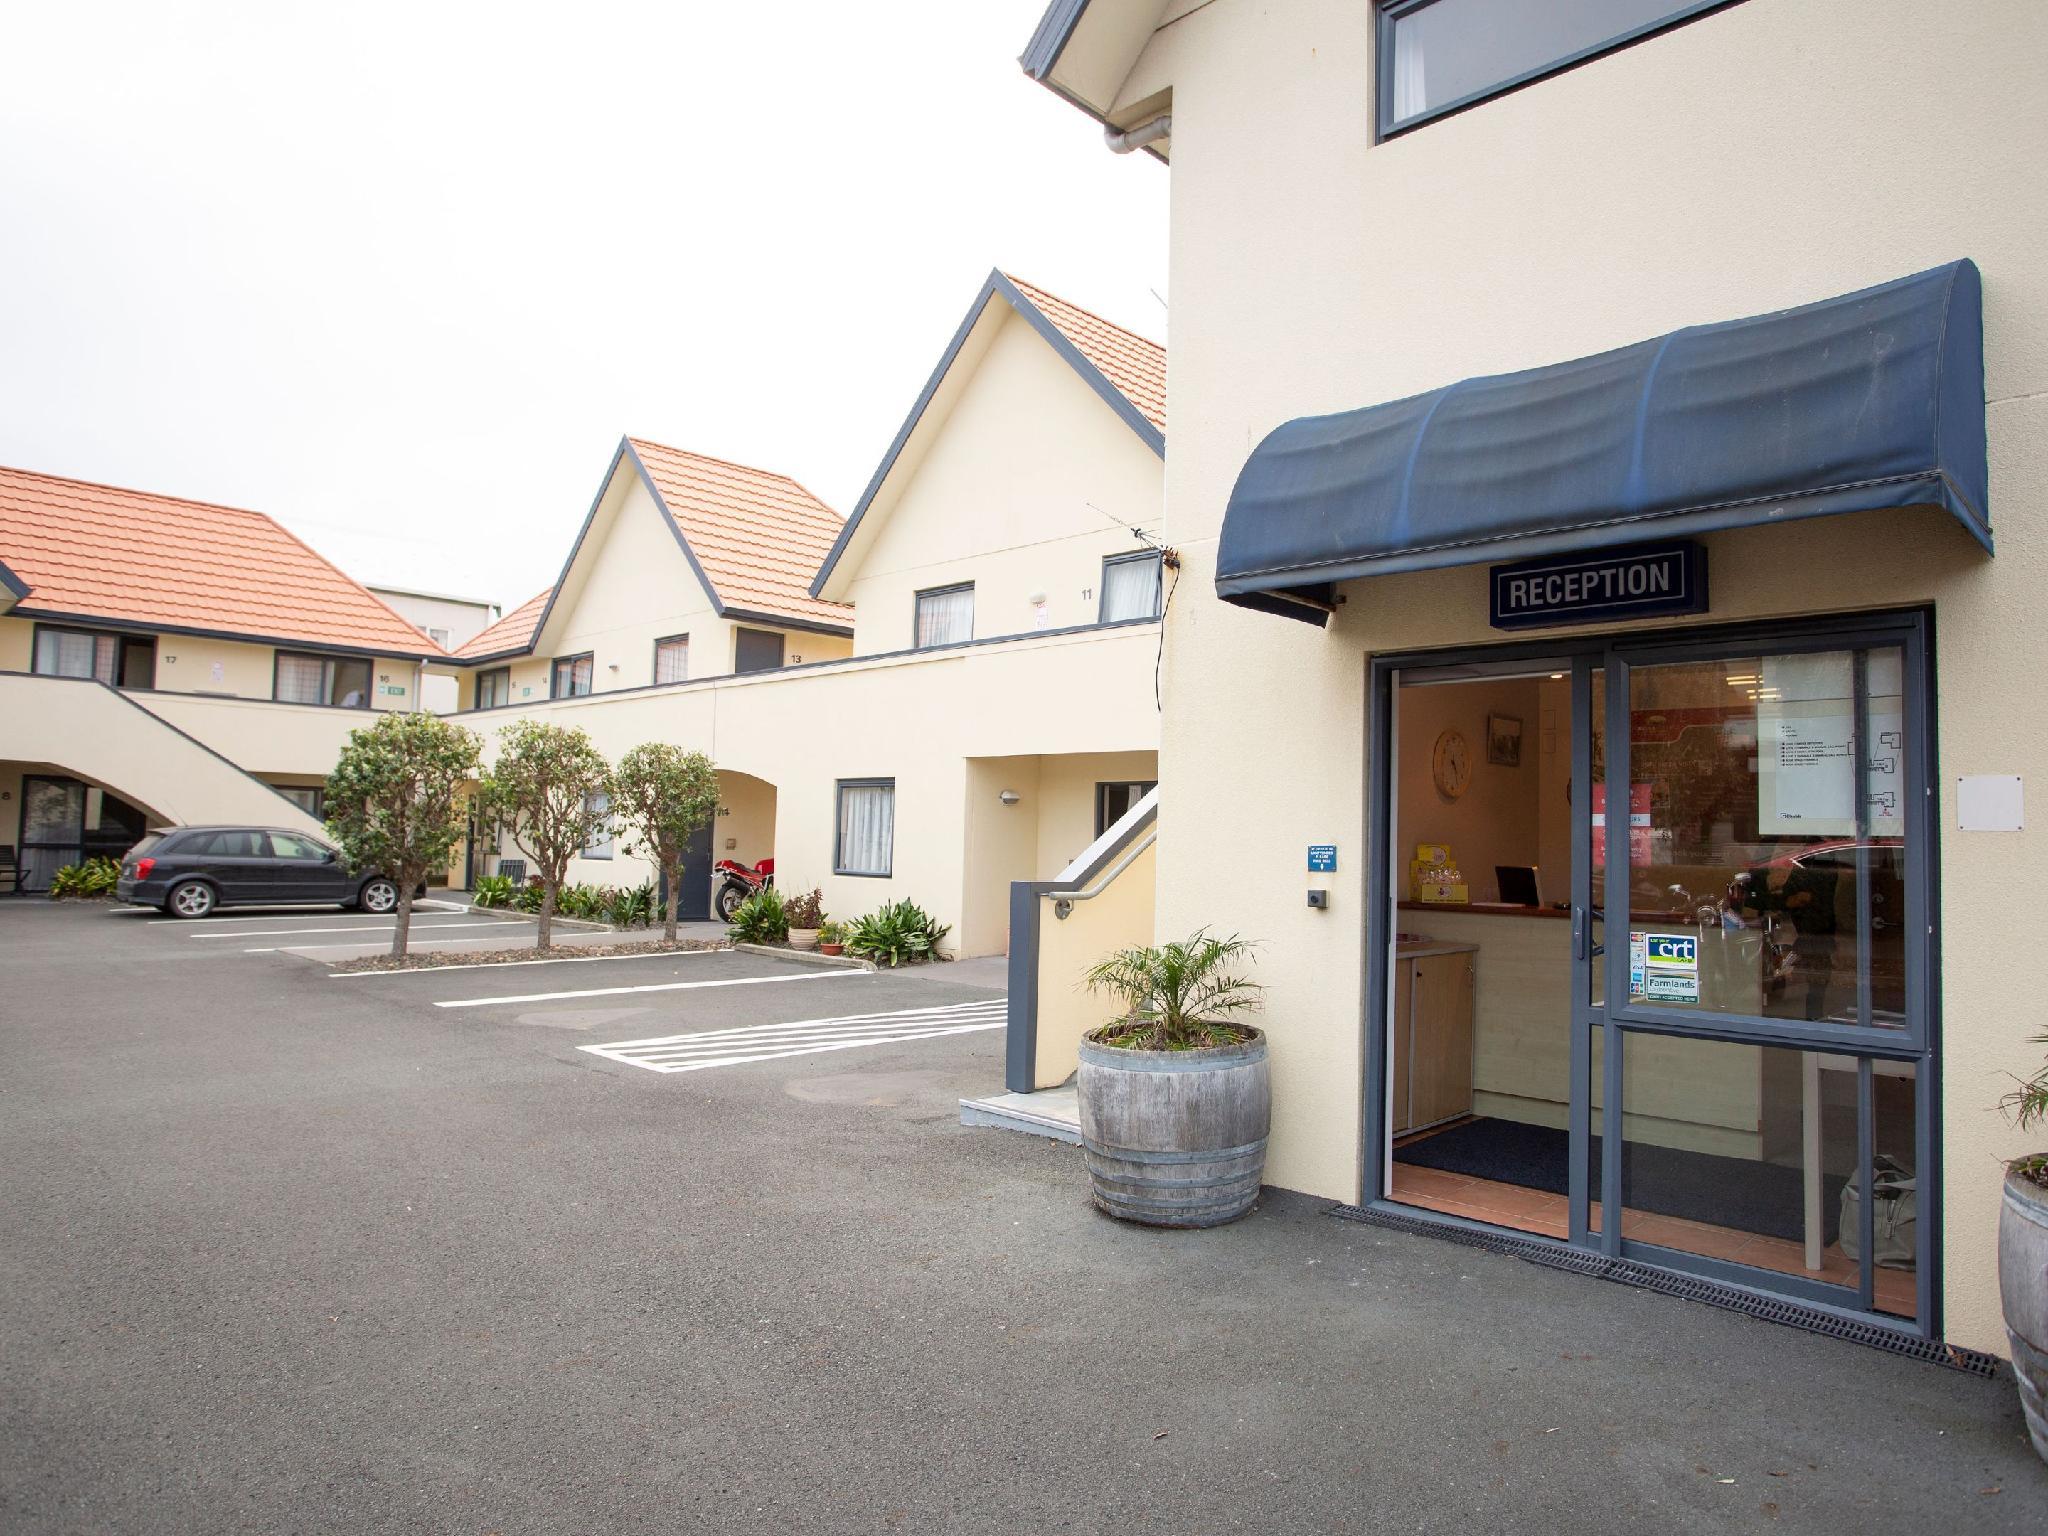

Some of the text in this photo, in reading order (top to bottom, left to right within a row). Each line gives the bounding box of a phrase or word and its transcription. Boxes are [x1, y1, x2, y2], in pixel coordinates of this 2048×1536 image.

[1510, 561, 1669, 608] RECEPTION
[1082, 588, 1092, 600] 11
[165, 656, 177, 664] 17
[791, 655, 801, 664] 13
[1, 791, 11, 800] 8
[1659, 940, 1693, 958] crt
[1649, 979, 1695, 988] Farmlands
